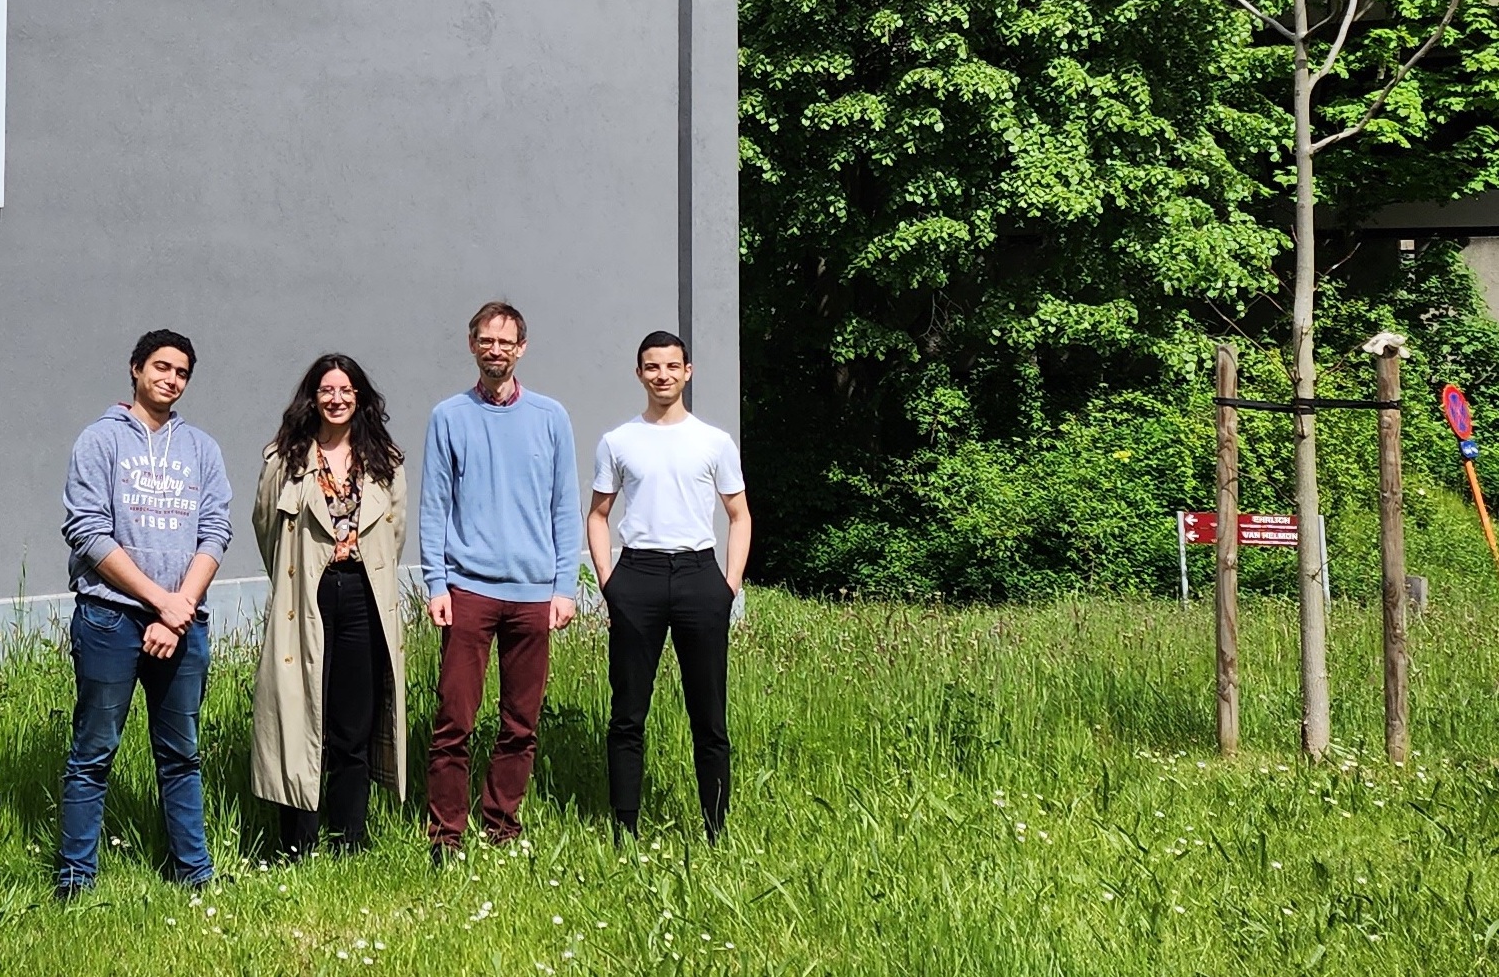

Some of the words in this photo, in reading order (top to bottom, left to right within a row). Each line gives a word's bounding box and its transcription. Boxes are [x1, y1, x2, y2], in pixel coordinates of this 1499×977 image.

[120, 455, 191, 477] VINTAGE
[130, 470, 184, 496] Laundry
[122, 493, 197, 511] OUTFITTERS
[140, 514, 178, 530] 1968
[1261, 531, 1298, 540] HELMON
